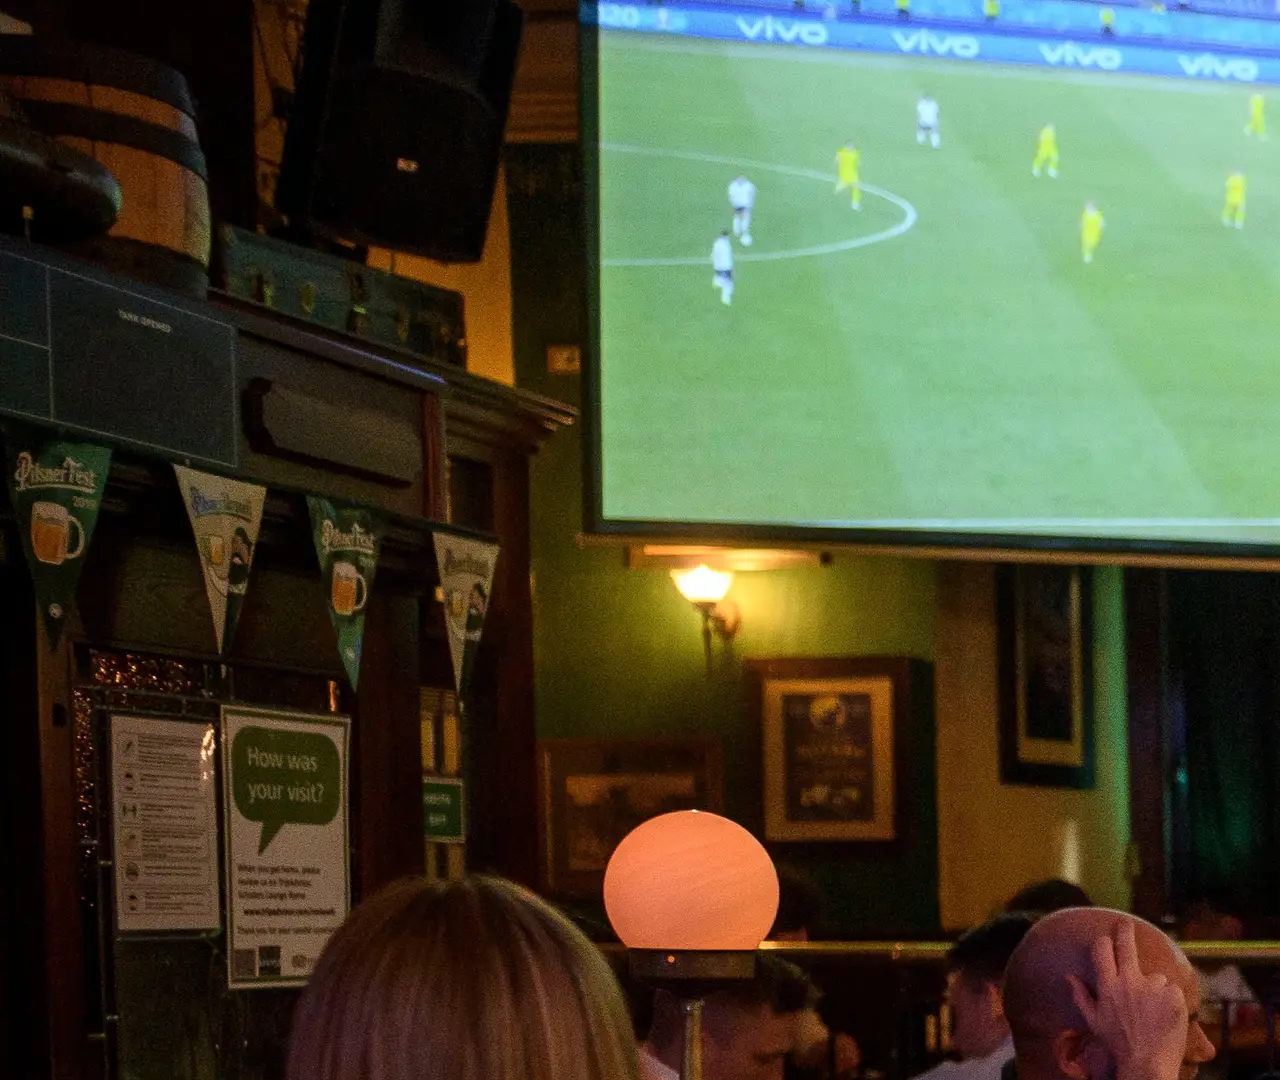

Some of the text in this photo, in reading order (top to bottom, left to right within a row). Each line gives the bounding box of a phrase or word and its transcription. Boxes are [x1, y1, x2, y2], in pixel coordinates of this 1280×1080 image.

[736, 15, 828, 45] vivo
[892, 28, 979, 57] vivo
[1038, 42, 1122, 69] vivo
[1178, 54, 1259, 81] vivo
[247, 745, 319, 773] How was
[247, 780, 325, 804] your visit?
